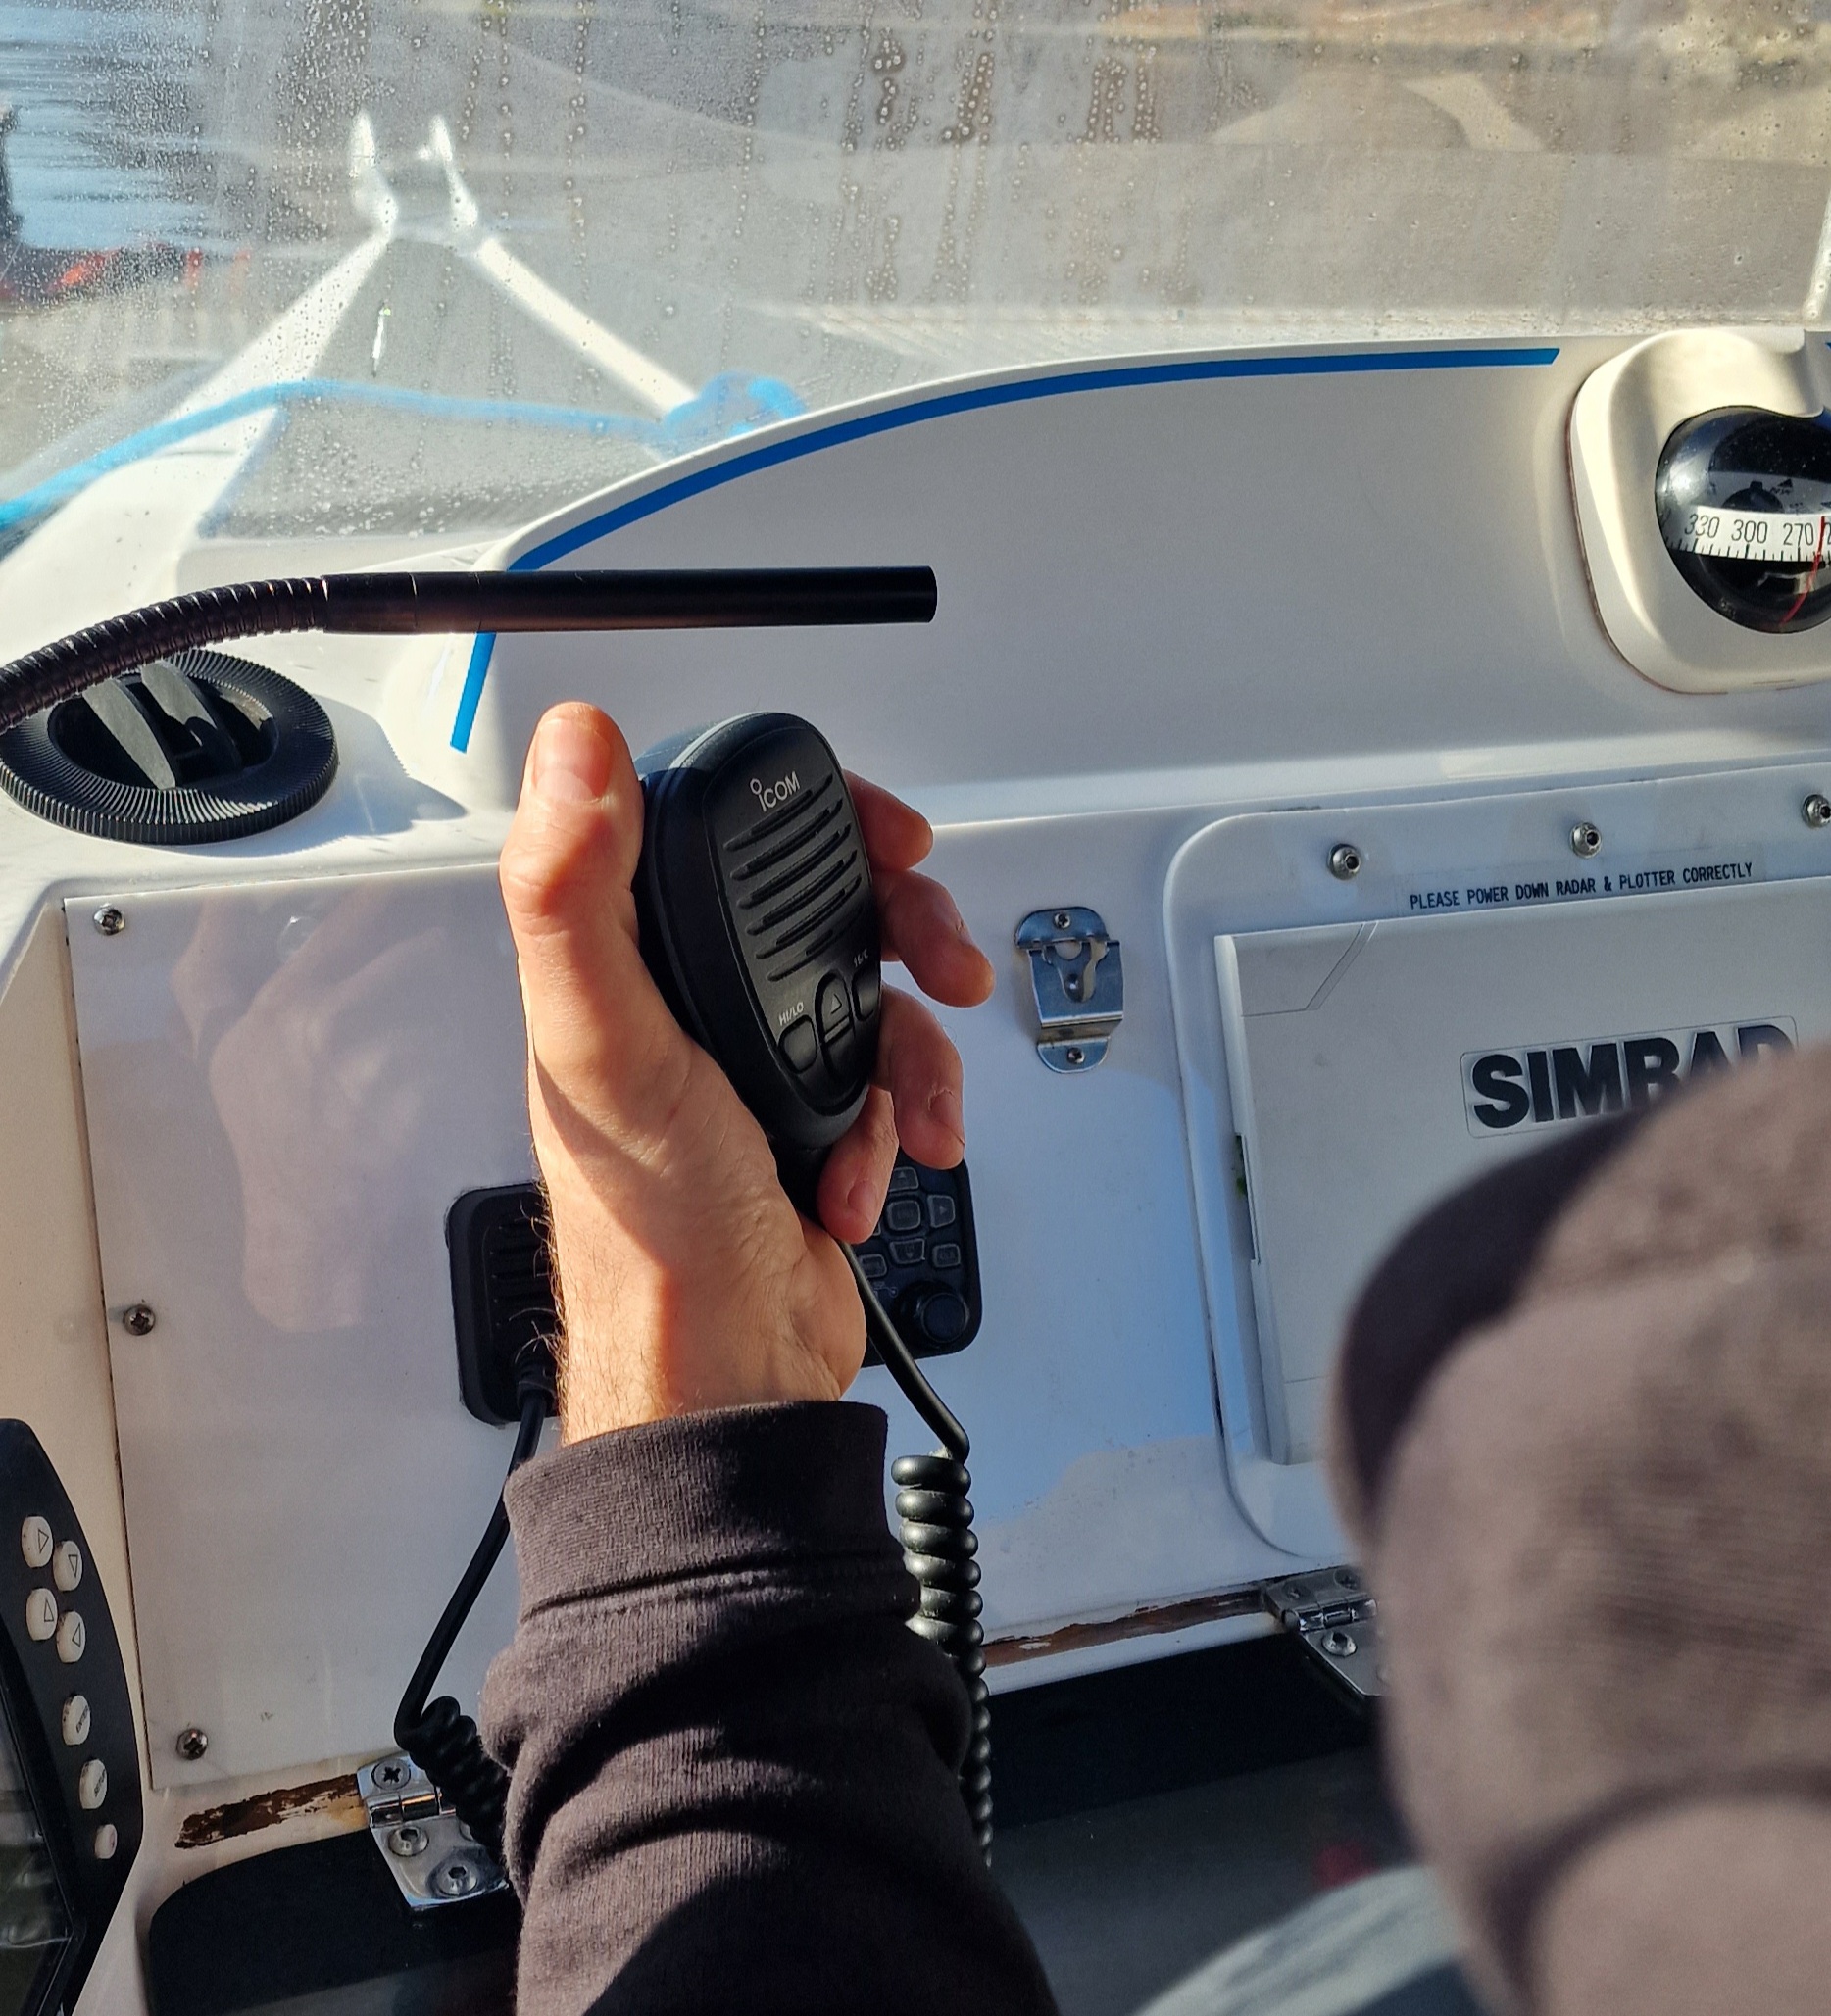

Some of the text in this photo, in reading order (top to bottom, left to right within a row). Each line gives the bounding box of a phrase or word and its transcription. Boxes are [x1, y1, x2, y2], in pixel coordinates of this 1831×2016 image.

[1684, 513, 1720, 539] 330
[1731, 519, 1768, 544] 300
[1782, 522, 1814, 547] 270
[1410, 862, 1753, 910] PLEASE POWER DOWN RADAR & PLOTTER CORRECTLY
[778, 1001, 804, 1027] HI/LO
